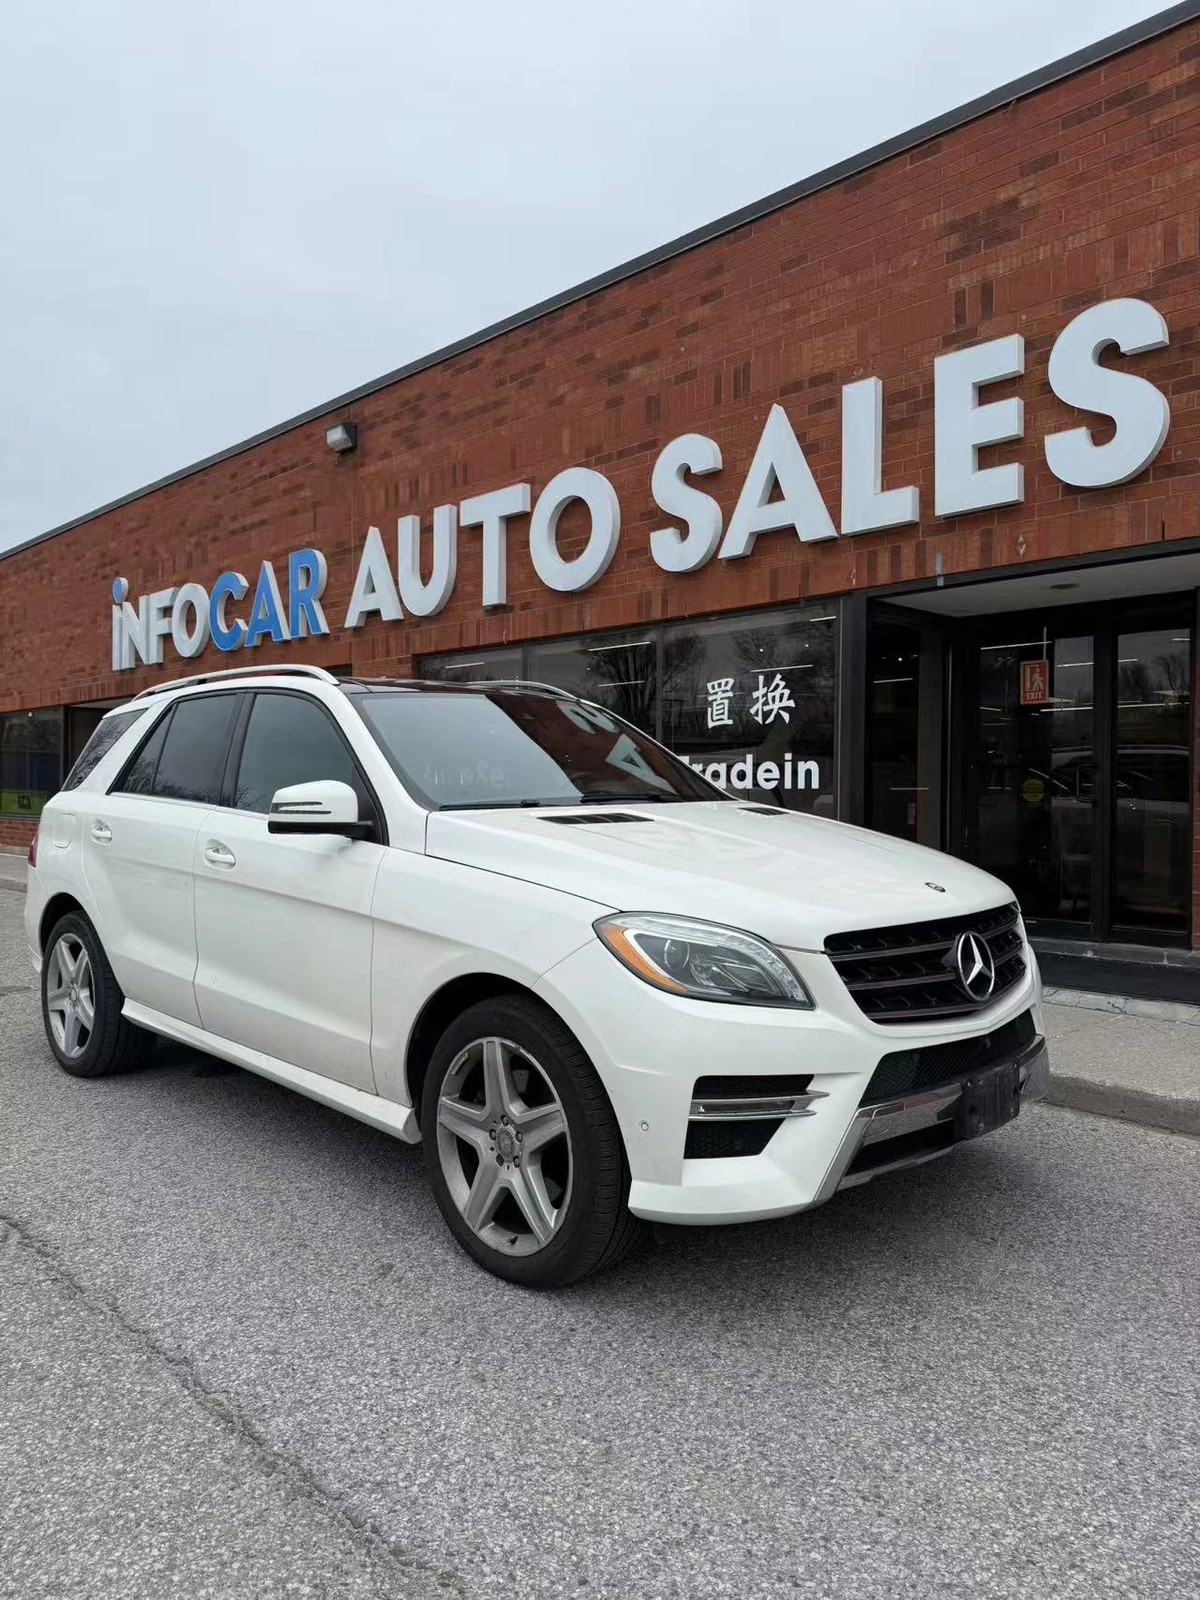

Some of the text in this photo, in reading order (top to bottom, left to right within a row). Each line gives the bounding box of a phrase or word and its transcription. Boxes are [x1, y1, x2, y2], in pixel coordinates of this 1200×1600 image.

[344, 467, 621, 629] AUTO
[650, 298, 1170, 573] SALES
[706, 673, 796, 729] 置换
[1026, 691, 1042, 700] EXIT
